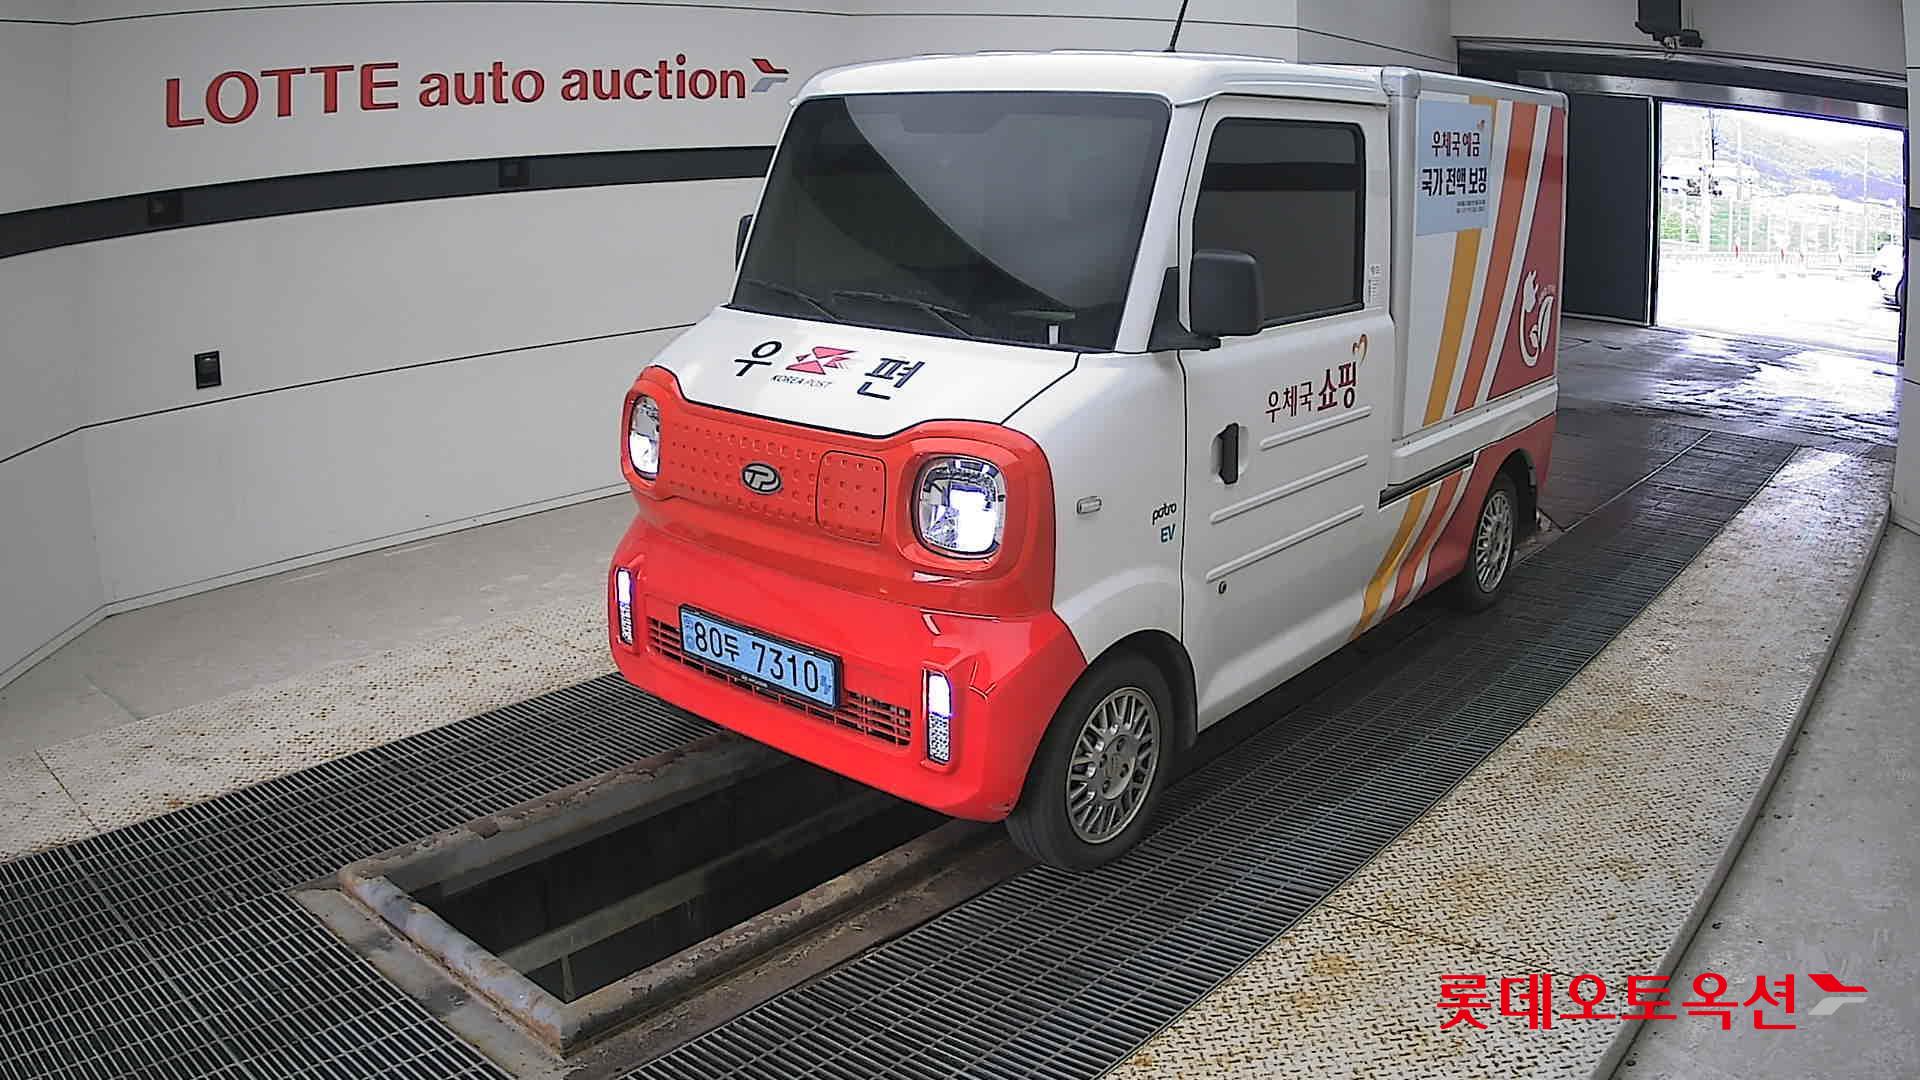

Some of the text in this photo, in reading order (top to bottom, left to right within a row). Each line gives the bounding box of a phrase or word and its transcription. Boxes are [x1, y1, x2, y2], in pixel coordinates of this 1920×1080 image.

[166, 54, 746, 128] LOTTE auto auction
[1432, 131, 1460, 157] 우체국
[1422, 167, 1487, 196] 국가 전액 보장
[772, 374, 804, 385] KOREA
[1265, 361, 1358, 423] 우체국 쇼핑
[1161, 523, 1176, 543] EV
[694, 621, 740, 662] 80두
[752, 641, 819, 693] 7310
